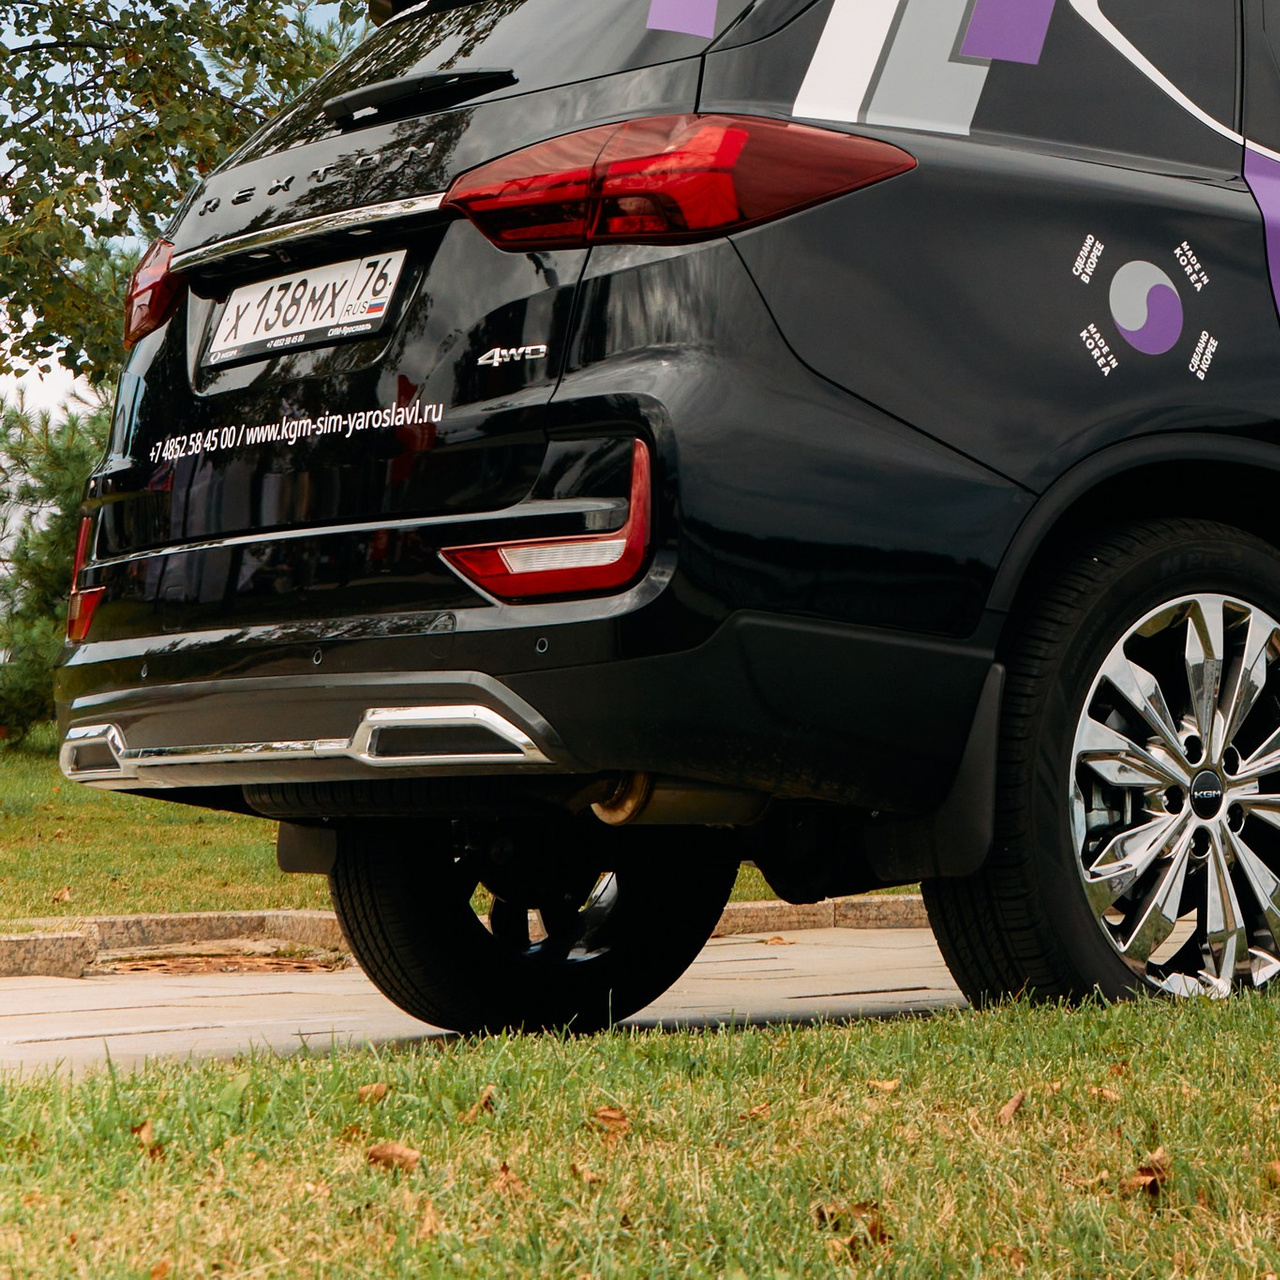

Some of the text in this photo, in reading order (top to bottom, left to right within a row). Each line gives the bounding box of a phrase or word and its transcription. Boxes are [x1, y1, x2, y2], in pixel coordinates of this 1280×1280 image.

[198, 142, 435, 217] REXTON
[1072, 234, 1095, 276] СДЕЛАНО
[1085, 240, 1105, 276] КОРЕЕ
[1173, 246, 1204, 292] KOREA
[1180, 241, 1210, 285] MADE IN
[343, 300, 369, 317] RUS
[477, 344, 547, 367] 4WD
[1079, 329, 1111, 376] KOREA
[1087, 323, 1119, 369] MADE IN
[1188, 330, 1209, 372] СДЕЛАНО
[1200, 336, 1219, 373] КОРЕЕ
[149, 442, 163, 463] +7
[161, 435, 187, 461] 4852
[188, 432, 203, 456] 58
[203, 429, 219, 452] 45
[220, 425, 236, 450] 00
[246, 399, 444, 445] www.kgm-sim-yaroslavl.ru
[1194, 790, 1222, 799] KGM
